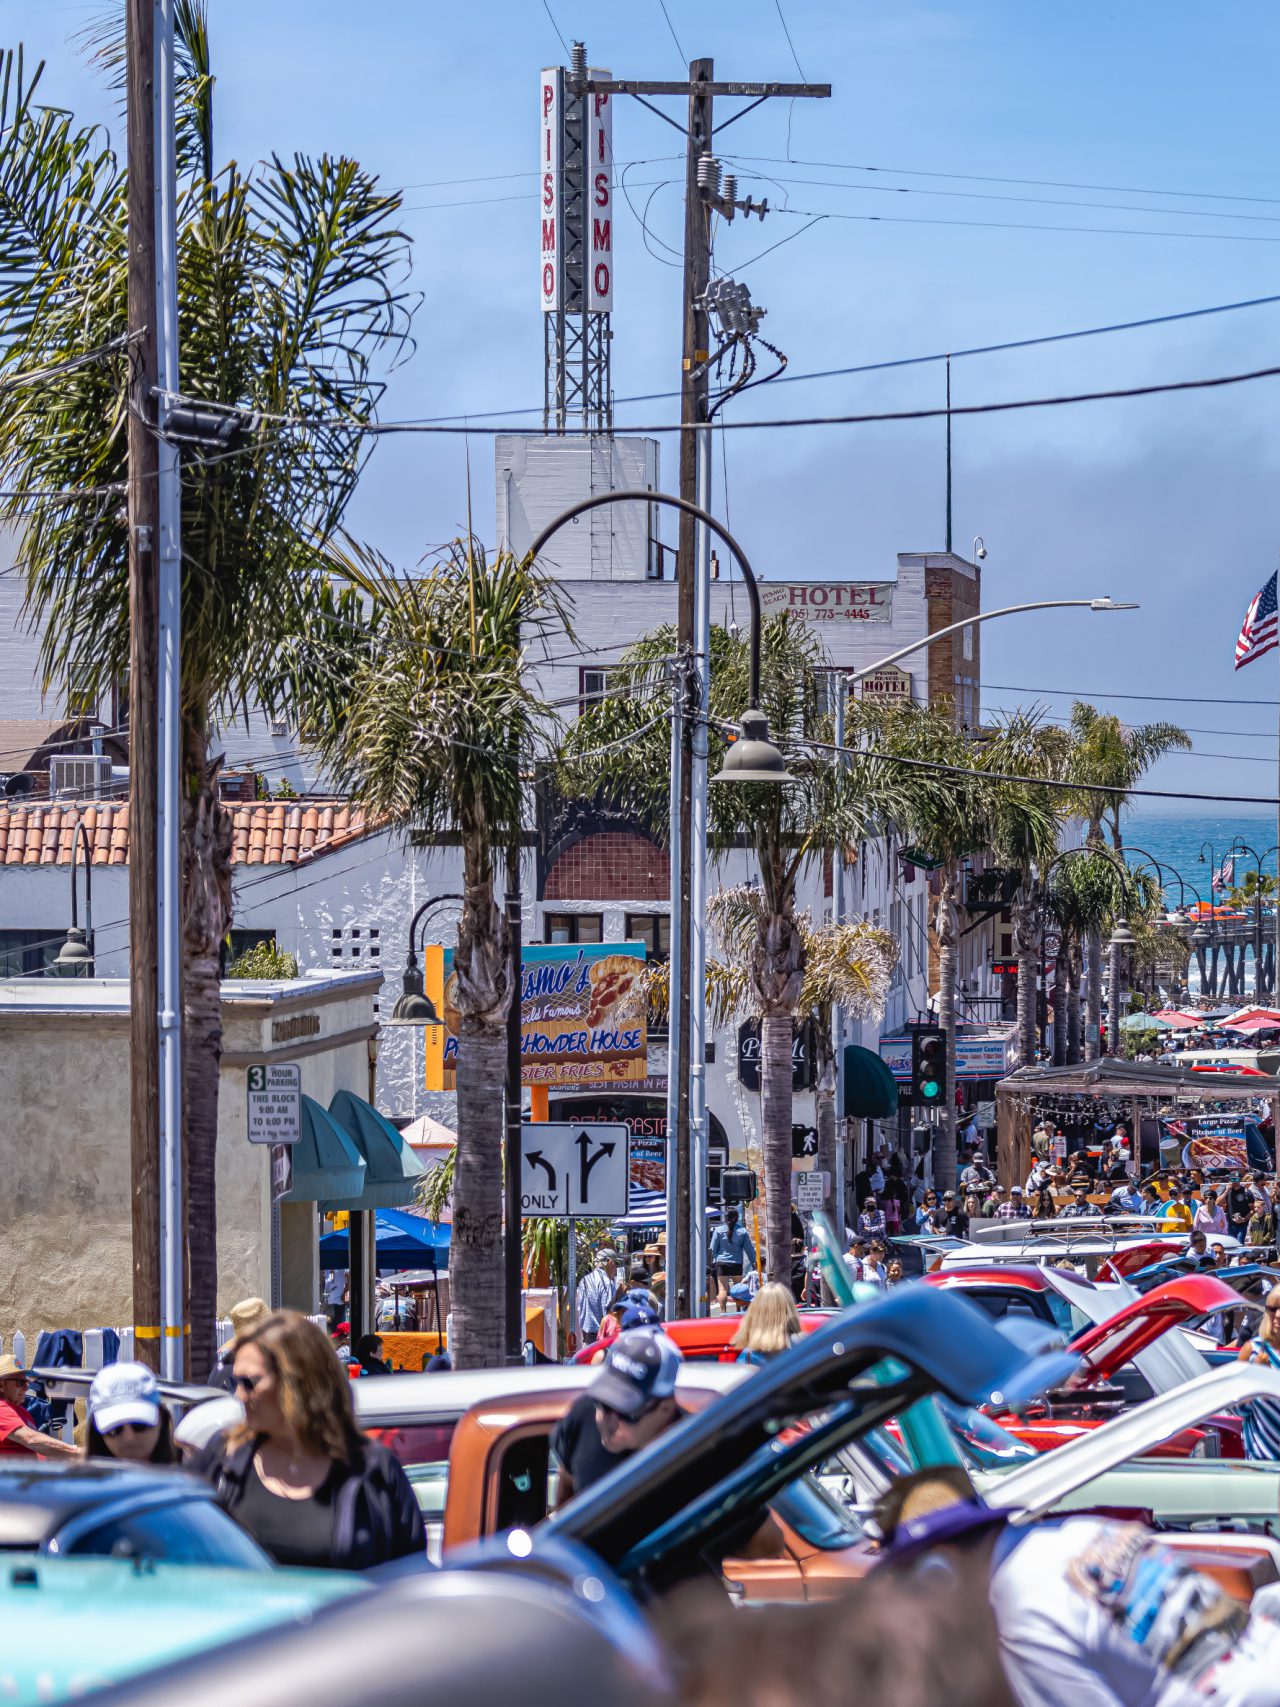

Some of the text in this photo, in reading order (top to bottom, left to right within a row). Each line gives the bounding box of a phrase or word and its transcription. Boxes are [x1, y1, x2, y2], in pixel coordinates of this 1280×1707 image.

[542, 84, 555, 298] PISMO
[593, 93, 611, 298] PISMO
[761, 588, 785, 600] PISMO
[763, 593, 787, 606] BEACH
[788, 586, 885, 606] HOTEL
[780, 608, 809, 620] (05)
[864, 681, 909, 692] HOTEL
[520, 949, 590, 1000] ismo's
[521, 1004, 582, 1024] orld Famous
[590, 1028, 643, 1051] HOUSE
[559, 1063, 604, 1078] FRIES
[250, 1067, 292, 1090] 3 HOUR
[266, 1079, 297, 1087] PARKING
[643, 1079, 654, 1089] IN
[800, 1173, 806, 1185] 3
[521, 1194, 558, 1208] ONLY
